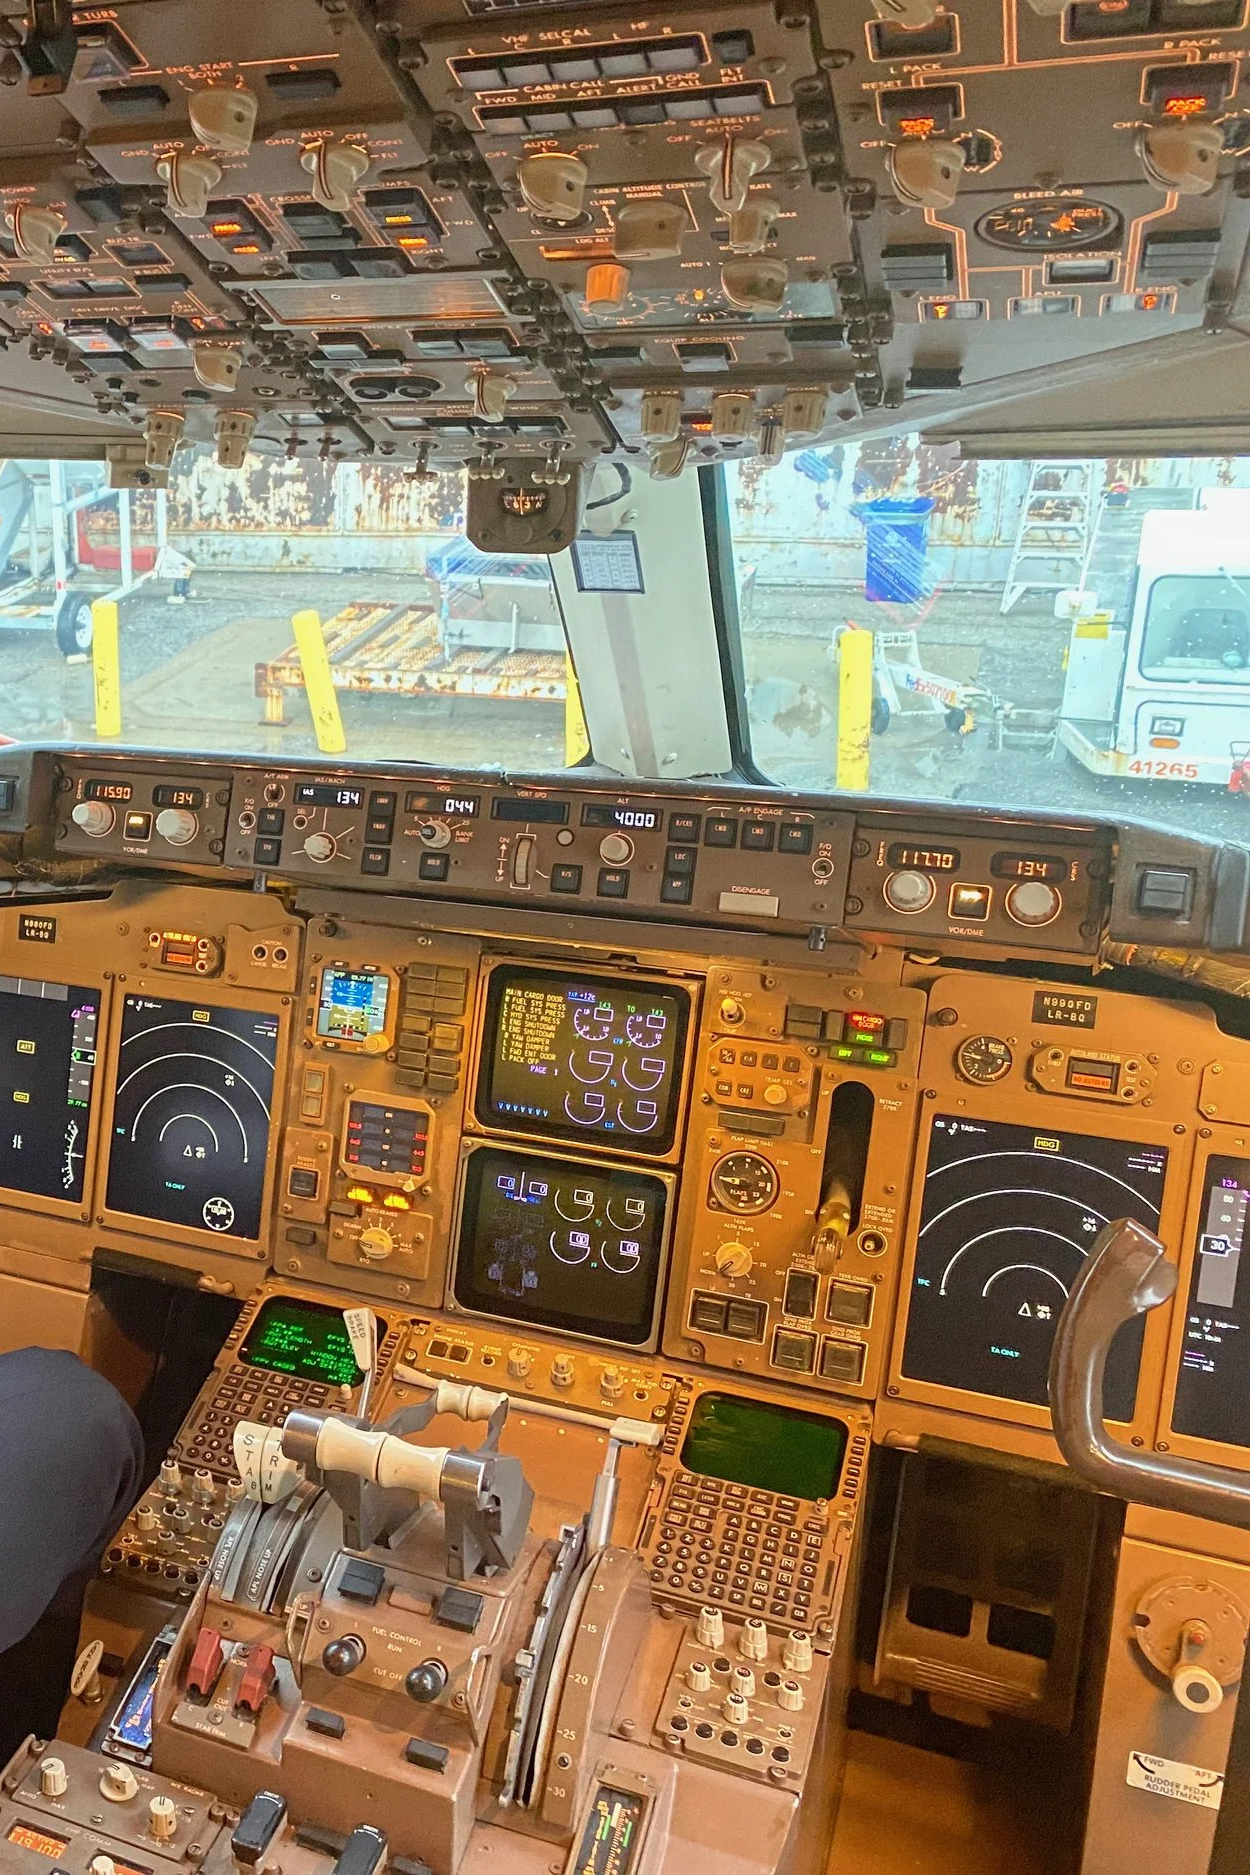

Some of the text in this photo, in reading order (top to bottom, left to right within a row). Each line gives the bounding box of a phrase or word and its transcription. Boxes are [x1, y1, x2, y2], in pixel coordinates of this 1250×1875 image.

[538, 28, 592, 41] SELCAL
[1180, 38, 1223, 48] PACK
[165, 65, 194, 75] ENG
[902, 63, 943, 74] PACK
[665, 72, 699, 81] GND
[523, 80, 604, 93] CABIN CALL
[616, 84, 658, 94] ALERT
[666, 80, 701, 89] CALL
[861, 80, 902, 90] RESET
[485, 96, 517, 104] FWD
[531, 93, 556, 101] MID
[1167, 97, 1206, 109] PACK
[689, 116, 761, 128] SEATBELTS
[900, 118, 934, 129] PACK
[299, 129, 334, 139] AUTO
[705, 125, 744, 133] AUTO
[152, 141, 184, 151] AUTO
[523, 140, 558, 149] AUTO
[622, 183, 663, 192] ALTITUDE
[1013, 189, 1083, 199] BLEED AIR
[1043, 251, 1122, 260] ISOLATION
[1129, 761, 1198, 778] 41265
[302, 788, 314, 796] IAS
[173, 792, 193, 804] 134
[336, 791, 360, 805] 134
[445, 799, 474, 813] 044
[753, 808, 784, 816] ENGAGE
[614, 811, 655, 828] 4000
[1016, 861, 1047, 877] 134
[1070, 861, 1078, 882] CRS
[731, 886, 771, 895] DISENGAGE
[948, 926, 984, 937] VOR/DME
[506, 988, 564, 1002] MAIN CARGO DOOR
[511, 997, 567, 1011] FUEL SYS PRESS
[511, 1003, 566, 1018] FUEL SYS PRESS
[651, 1008, 664, 1016] 143
[525, 1013, 538, 1021] SYS
[540, 1015, 561, 1025] PRESS
[509, 1018, 556, 1032] ENG SHUTDOWN
[508, 1025, 555, 1039] ENG SHUTDOWN
[512, 1033, 550, 1045] YAW DAMPER
[511, 1039, 550, 1052] YAW DAMPER
[508, 1054, 540, 1065] PACK OFF
[524, 1049, 536, 1058] ENT
[539, 1052, 557, 1061] DOOR
[530, 1065, 547, 1074] PAGE
[879, 1098, 902, 1107] RETRACT
[1037, 1139, 1056, 1150] HDG
[1221, 1179, 1238, 1189] 134
[1210, 1241, 1225, 1251] 30
[346, 1316, 359, 1340] BRAKE
[353, 1313, 366, 1338] SPEED
[243, 1434, 257, 1490] STAB
[252, 1549, 272, 1593] APL NOSE UP
[794, 1610, 805, 1618] CLR
[389, 1631, 421, 1647] CONTROL
[387, 1643, 402, 1653] RUN
[373, 1667, 387, 1677] CUT
[575, 1674, 589, 1685] 20
[217, 1697, 229, 1705] CUT
[214, 1703, 228, 1712] OUT
[195, 1723, 226, 1737] STAB TRIM
[563, 1729, 576, 1740] 25
[1144, 1756, 1164, 1767] FWD
[1195, 1771, 1212, 1779] AFT
[183, 1785, 205, 1797] RADAR
[1145, 1775, 1211, 1797] RUDDER PEDAL
[553, 1787, 566, 1798] 30
[1146, 1783, 1206, 1803] ADJUSTMENT
[82, 1833, 111, 1847] COMM
